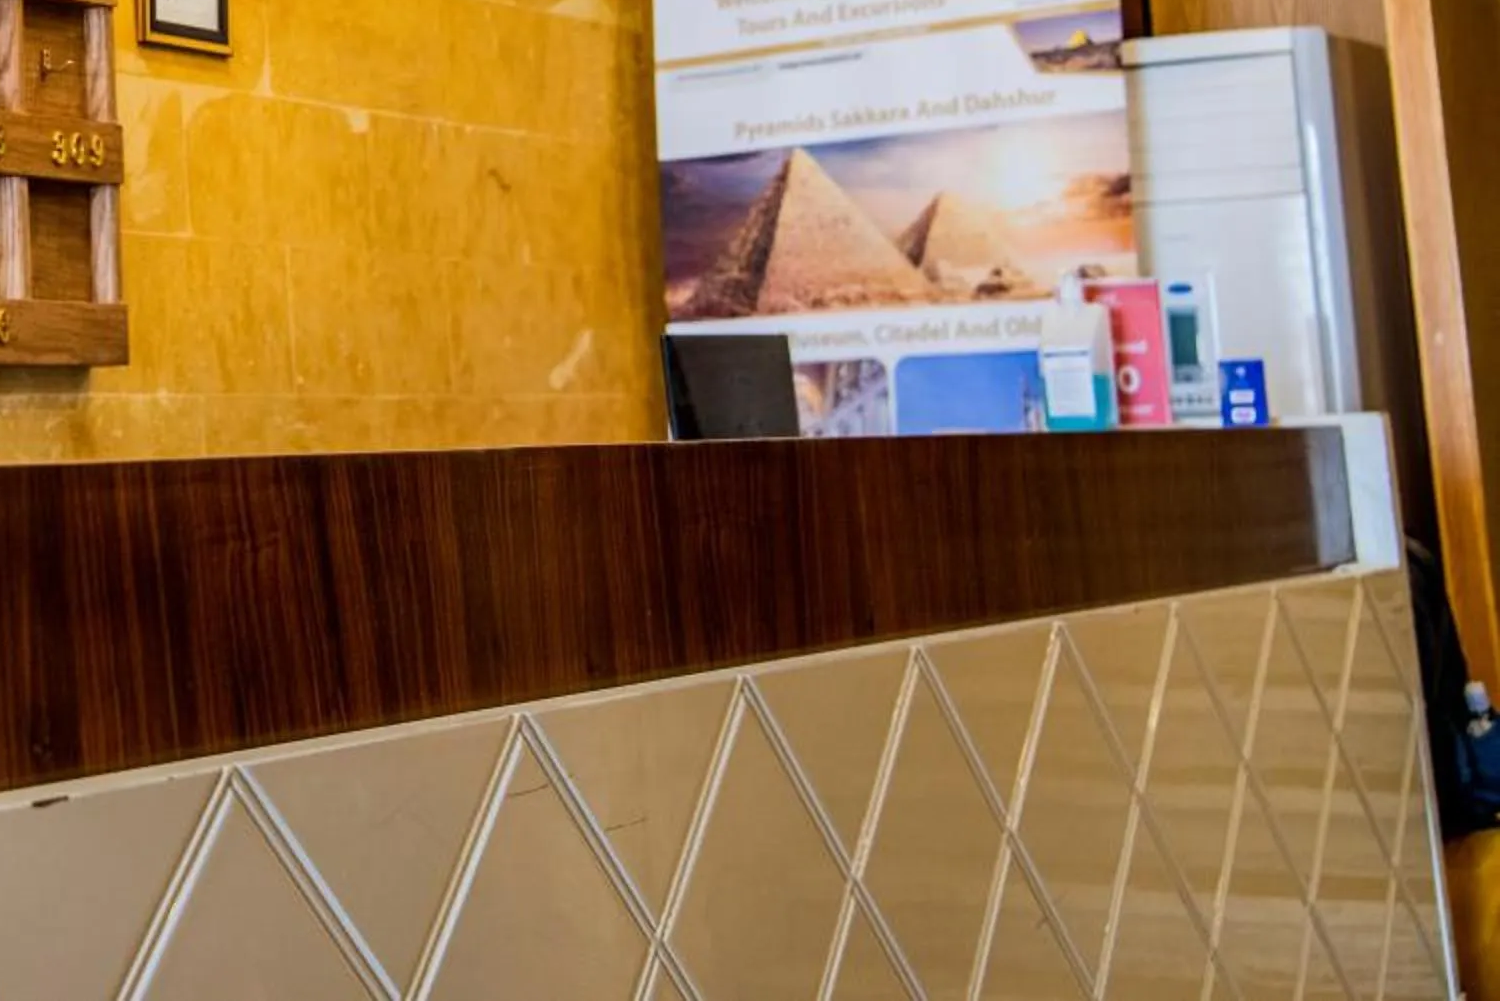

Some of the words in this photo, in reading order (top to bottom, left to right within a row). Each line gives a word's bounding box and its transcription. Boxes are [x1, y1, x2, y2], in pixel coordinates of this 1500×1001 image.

[735, 11, 787, 37] Tours
[792, 3, 834, 27] And
[733, 109, 825, 142] Pyramids
[829, 101, 910, 129] Sakkara
[917, 94, 959, 118] And
[964, 83, 1057, 116] Dahshur
[51, 130, 104, 168] 309
[873, 317, 951, 344] Citadel
[955, 315, 1001, 337] And
